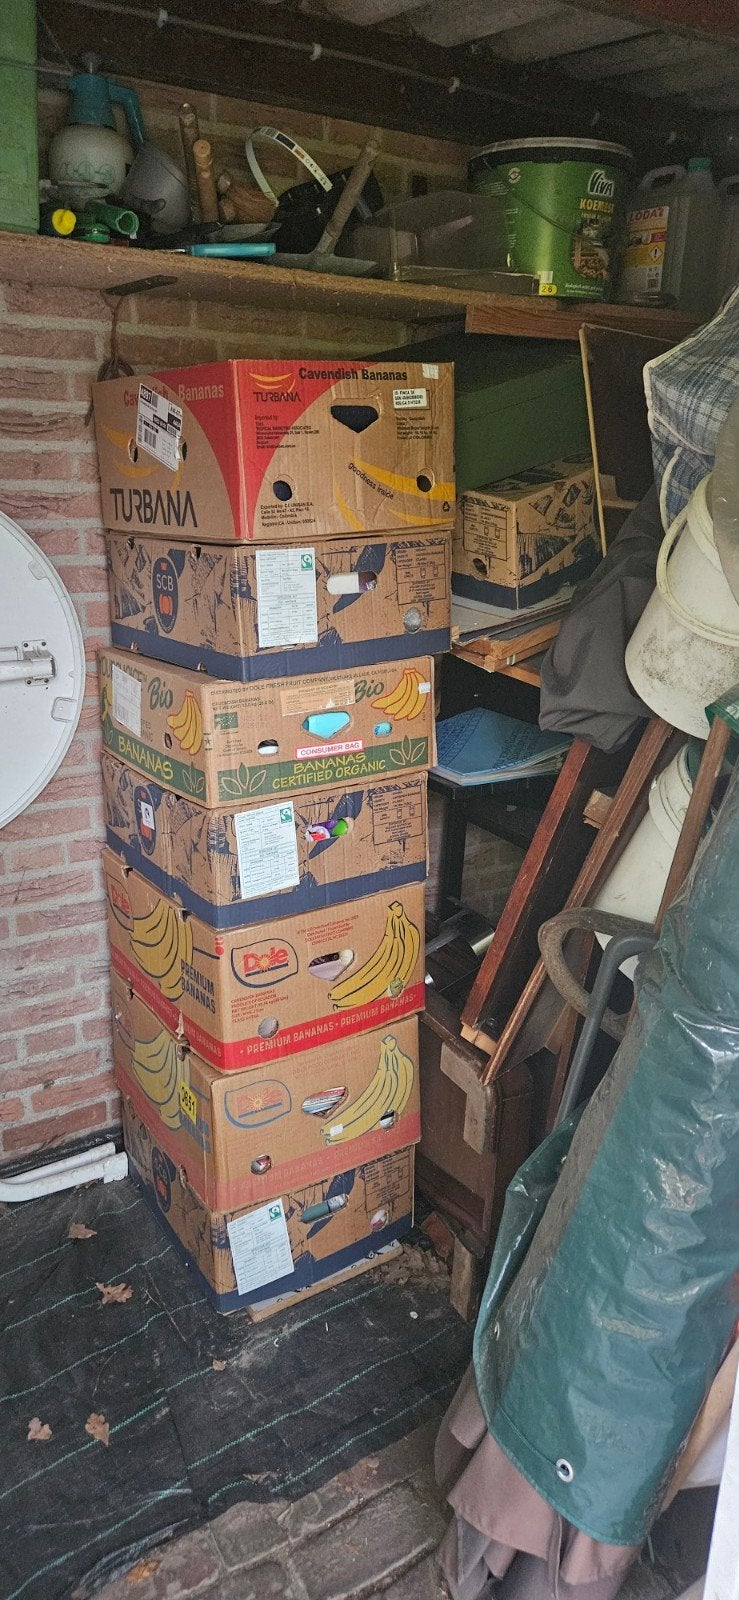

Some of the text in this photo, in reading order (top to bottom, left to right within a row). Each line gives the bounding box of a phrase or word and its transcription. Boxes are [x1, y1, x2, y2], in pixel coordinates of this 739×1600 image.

[299, 367, 408, 381] Cavendish Bananas
[179, 384, 224, 401] Bananas
[253, 391, 300, 402] TURBANA
[348, 463, 394, 500] goodness inside
[110, 487, 198, 528] TURBANA
[156, 574, 174, 591] SCB
[147, 676, 173, 710] Bio
[354, 680, 385, 703] Bio
[118, 736, 174, 780] BANANAS
[293, 752, 366, 774] BANANAS
[300, 742, 360, 756] CONSUMER BAG
[272, 760, 386, 790] CERTIFIED ORGANIC
[243, 947, 289, 973] Dole
[181, 959, 215, 996] PREMIUM
[181, 976, 216, 1014] BANANAS
[246, 996, 413, 1055] PREMIUM BANANAS PREMIUM BANANAS
